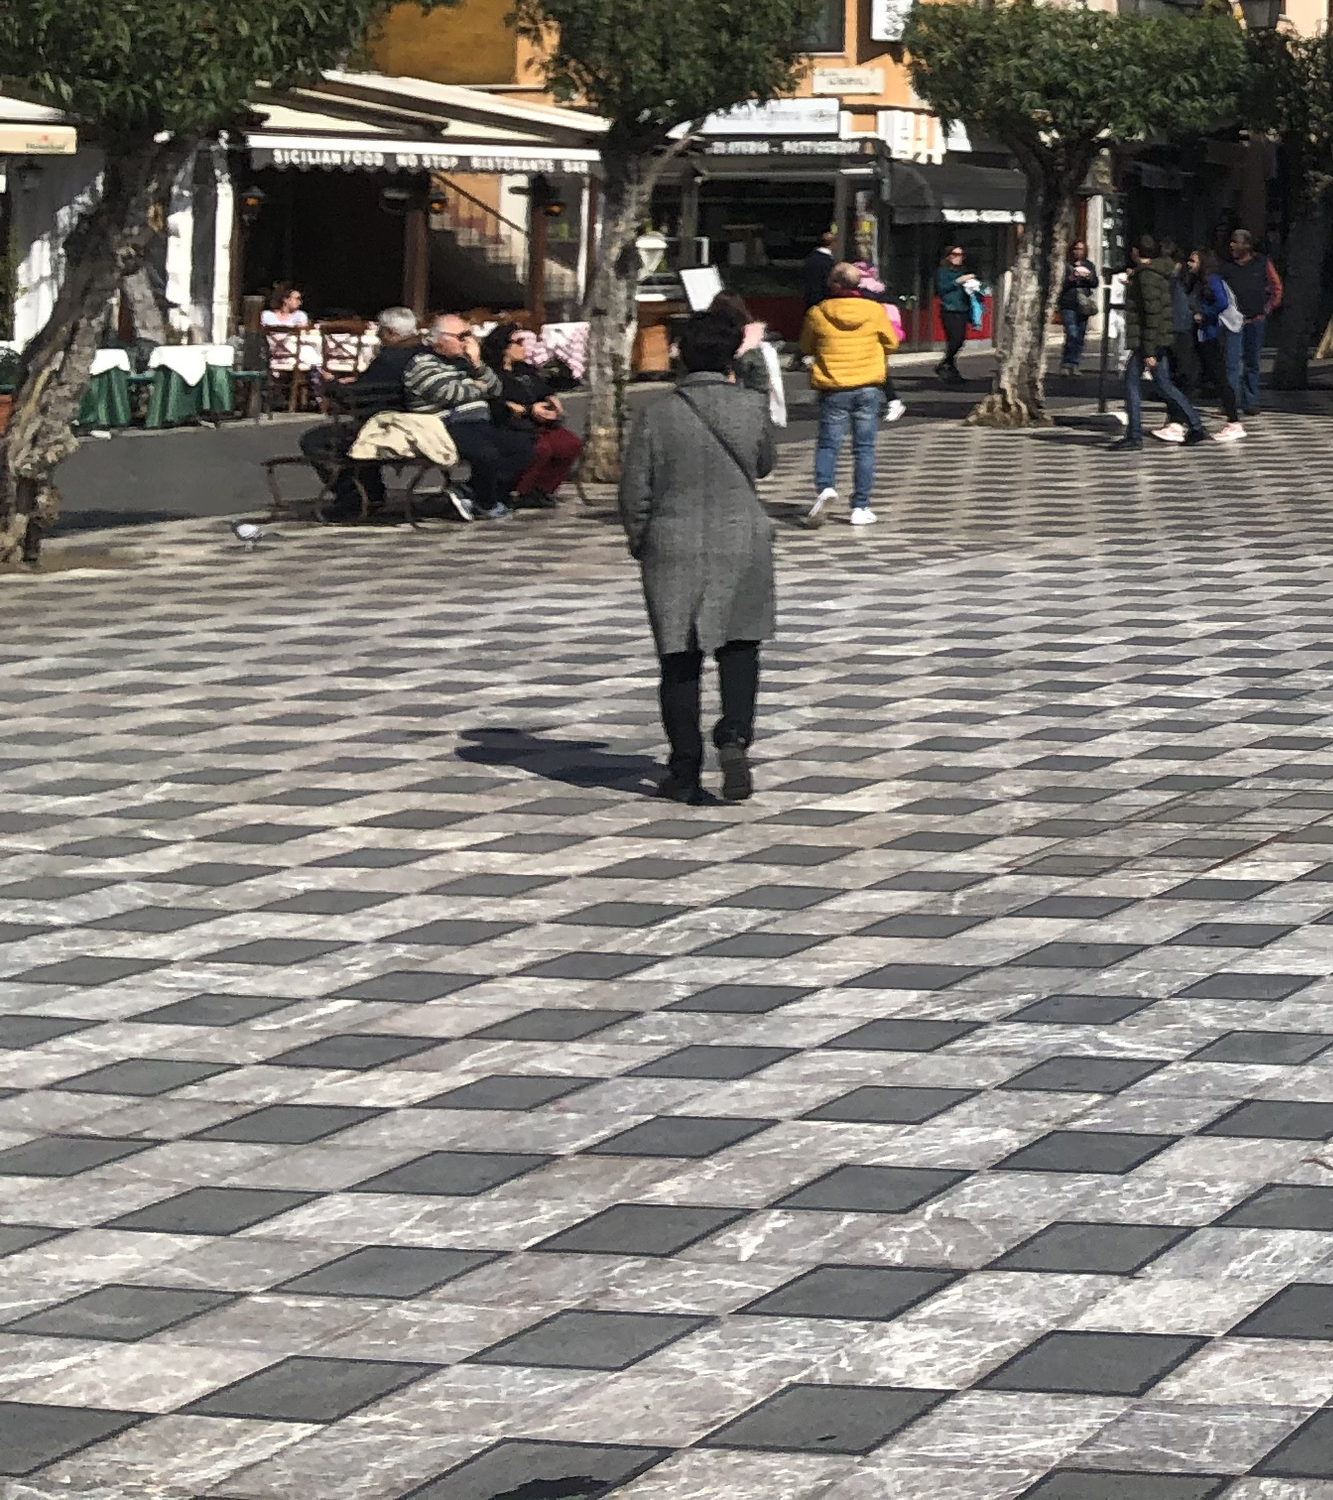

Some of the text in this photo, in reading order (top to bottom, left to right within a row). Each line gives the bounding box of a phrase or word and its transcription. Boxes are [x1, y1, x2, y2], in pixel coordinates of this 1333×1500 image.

[272, 148, 341, 165] SICILIAN
[343, 150, 385, 166] FOOD
[395, 152, 419, 168] NO
[422, 154, 459, 169] STOP
